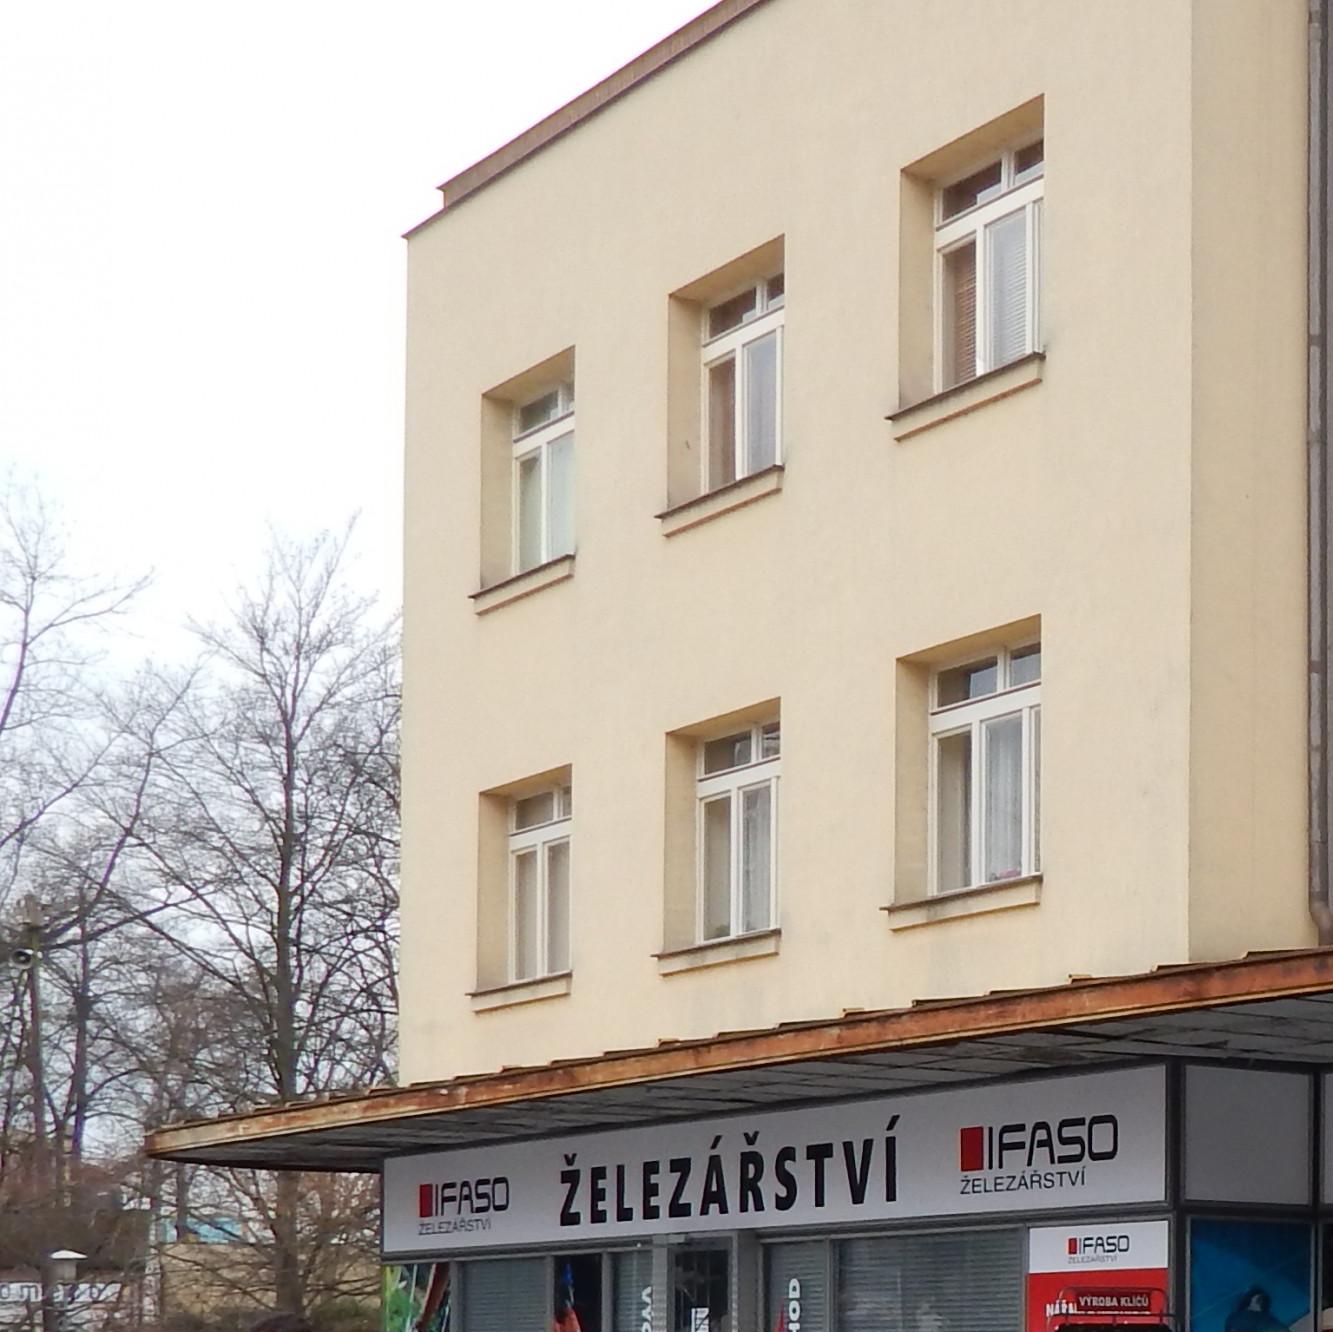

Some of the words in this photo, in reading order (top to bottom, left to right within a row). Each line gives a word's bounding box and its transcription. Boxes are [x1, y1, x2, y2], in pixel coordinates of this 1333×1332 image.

[987, 1114, 1118, 1171] IFASO
[560, 1115, 900, 1227] ŽELEZÁŘSTVÍ
[960, 1166, 1085, 1195] ŽELEZÁŘSTVÍ
[435, 1177, 510, 1217] IFASO
[1079, 1235, 1130, 1255] IFASO
[1079, 1294, 1119, 1307] VÝROBA
[1120, 1293, 1149, 1307] KLÍČŮ
